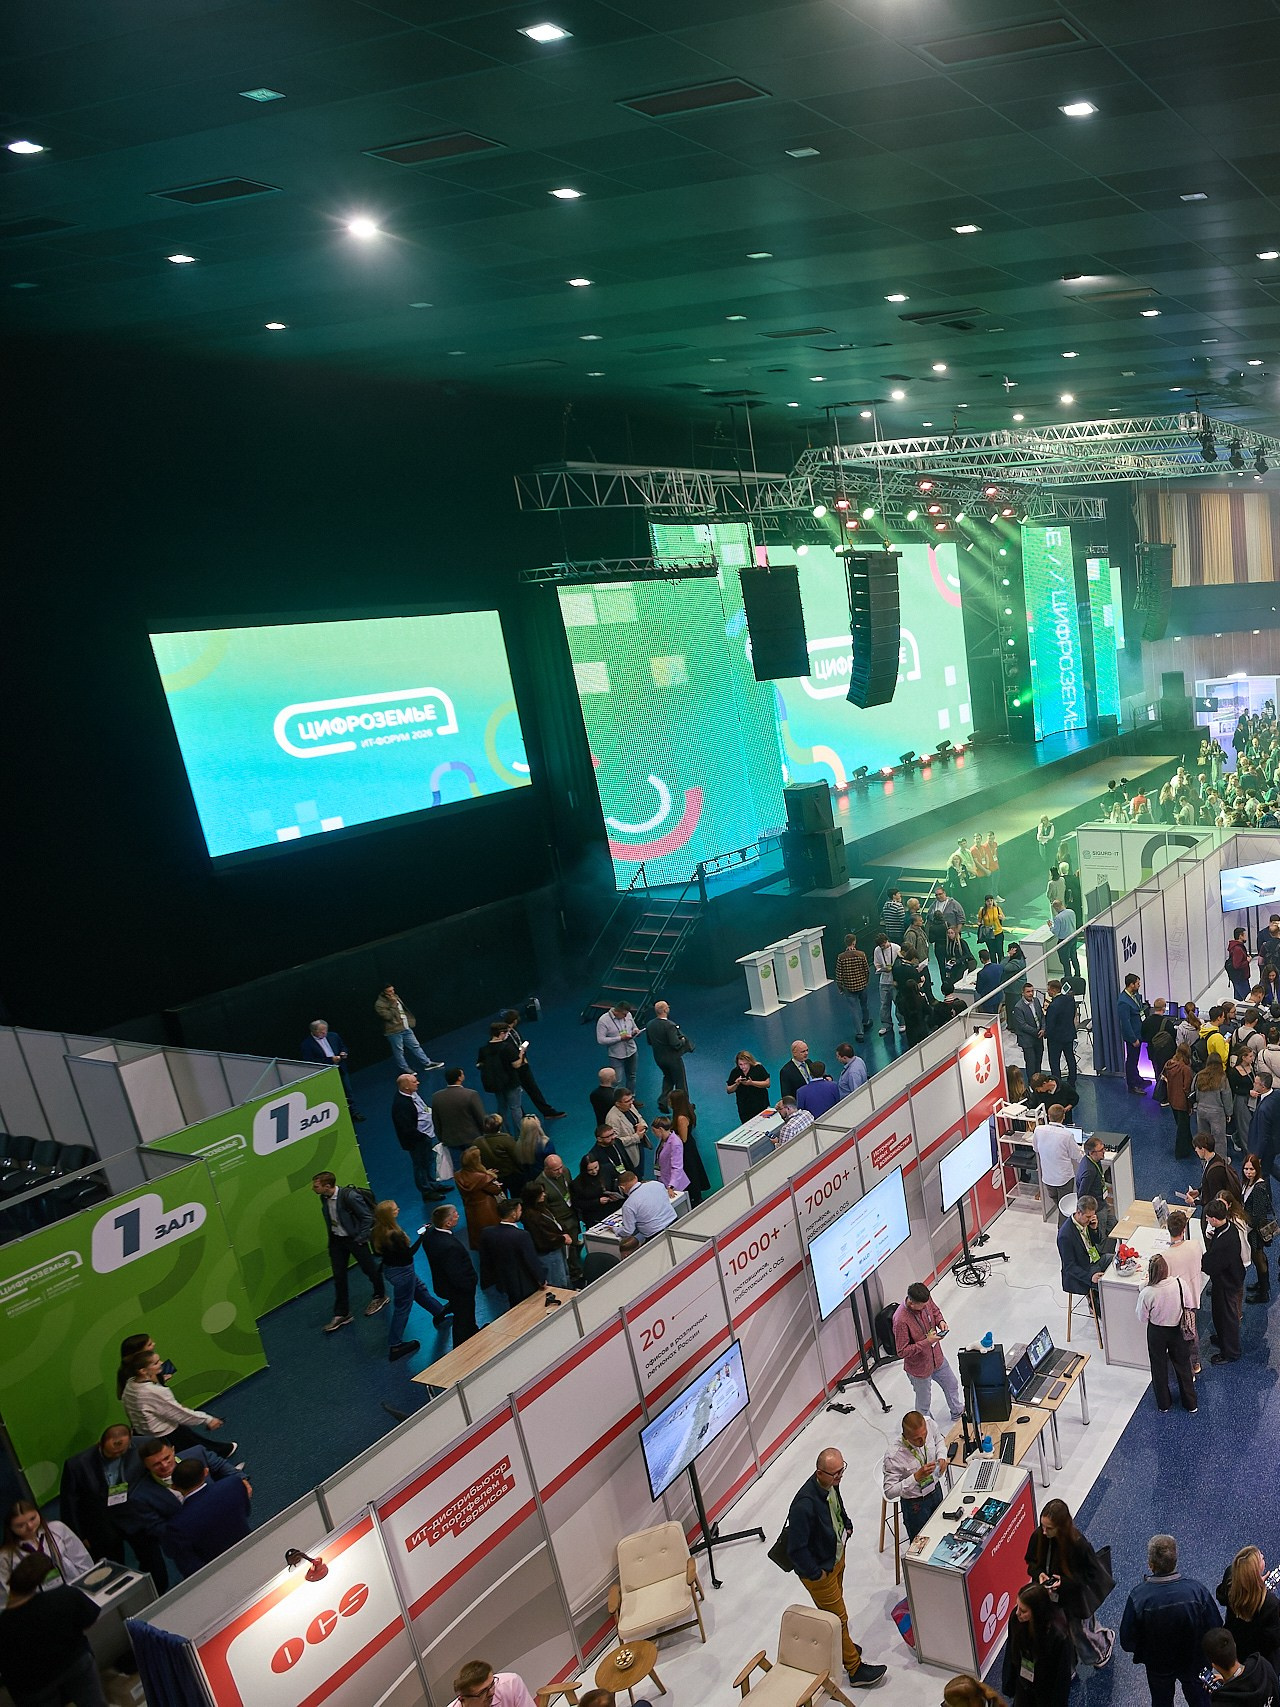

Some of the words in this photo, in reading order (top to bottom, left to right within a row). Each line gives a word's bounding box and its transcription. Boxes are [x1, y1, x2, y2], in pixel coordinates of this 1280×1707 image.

[297, 704, 438, 740] ЦИФРОЗЕМЬЕ
[361, 732, 411, 749] ИТ-ФОРУМ
[412, 729, 434, 740] 2026
[270, 1103, 289, 1143] 1
[300, 1108, 330, 1131] ЗАЛ
[804, 1169, 850, 1214] 7000+
[114, 1207, 140, 1258] 1
[154, 1210, 195, 1239] ЗАЛ
[729, 1228, 780, 1275] 1000+
[773, 1256, 785, 1269] OCS
[640, 1319, 665, 1352] 20
[645, 1346, 669, 1369] офисов
[675, 1313, 708, 1345] различных
[647, 1350, 677, 1379] регионах
[677, 1330, 700, 1351] России
[411, 1463, 507, 1545] ИТ-дистрибьютор
[432, 1531, 440, 1540] с
[441, 1480, 500, 1533] портфелем
[459, 1484, 509, 1528] сервисов
